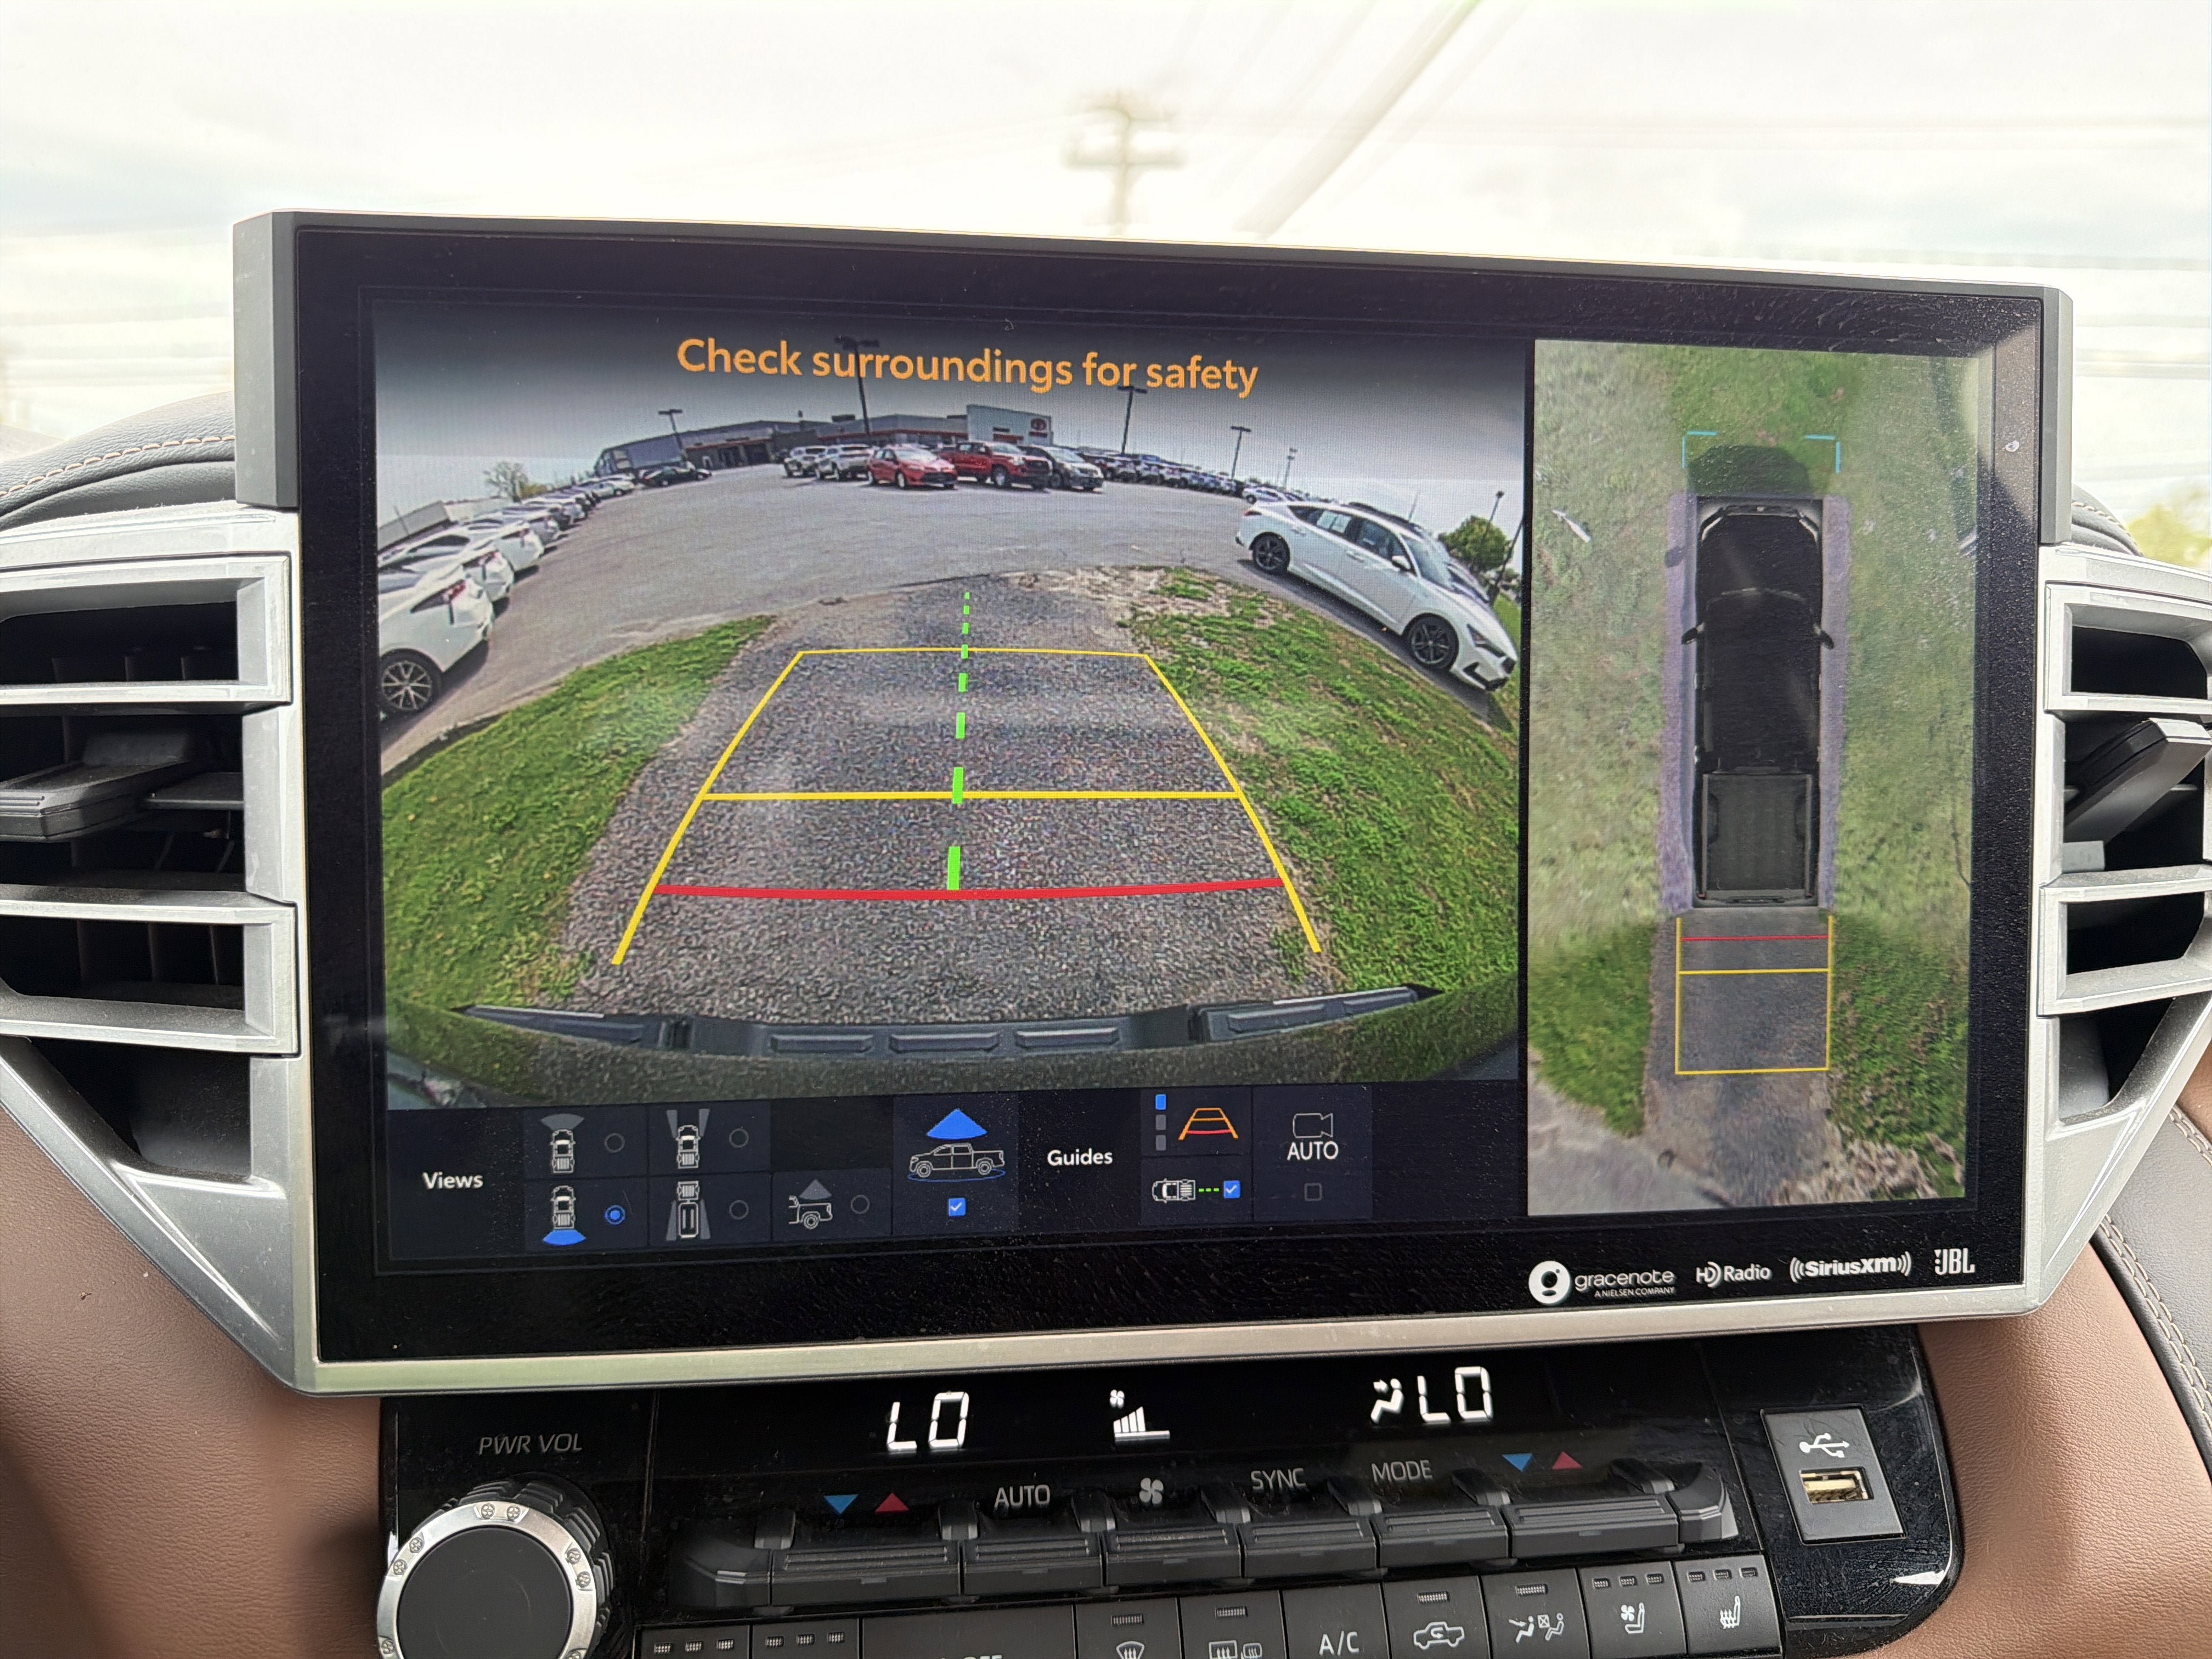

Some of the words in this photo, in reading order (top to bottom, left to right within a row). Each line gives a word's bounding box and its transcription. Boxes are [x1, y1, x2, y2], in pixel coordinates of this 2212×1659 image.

[677, 337, 802, 376] Check
[813, 348, 1073, 393] surroundings
[1082, 352, 1137, 387] for
[1147, 355, 1258, 398] safety
[1047, 1148, 1113, 1166] Guides
[1287, 1142, 1339, 1160] AUTO
[423, 1171, 483, 1189] Views
[1575, 1269, 1675, 1292] gracenote
[1696, 1261, 1722, 1288] HD
[1724, 1263, 1771, 1282] Radio
[1602, 1288, 1634, 1297] NIELSEN
[1635, 1286, 1675, 1296] COMPANY
[1418, 1366, 1494, 1424] LO
[886, 1391, 970, 1452] LO
[478, 1435, 531, 1455] PWR
[539, 1432, 583, 1453] VOL
[1250, 1467, 1306, 1490] SYNC
[1372, 1460, 1433, 1482] MODE
[994, 1485, 1051, 1508] AUTO
[1319, 1631, 1359, 1656] A/C
